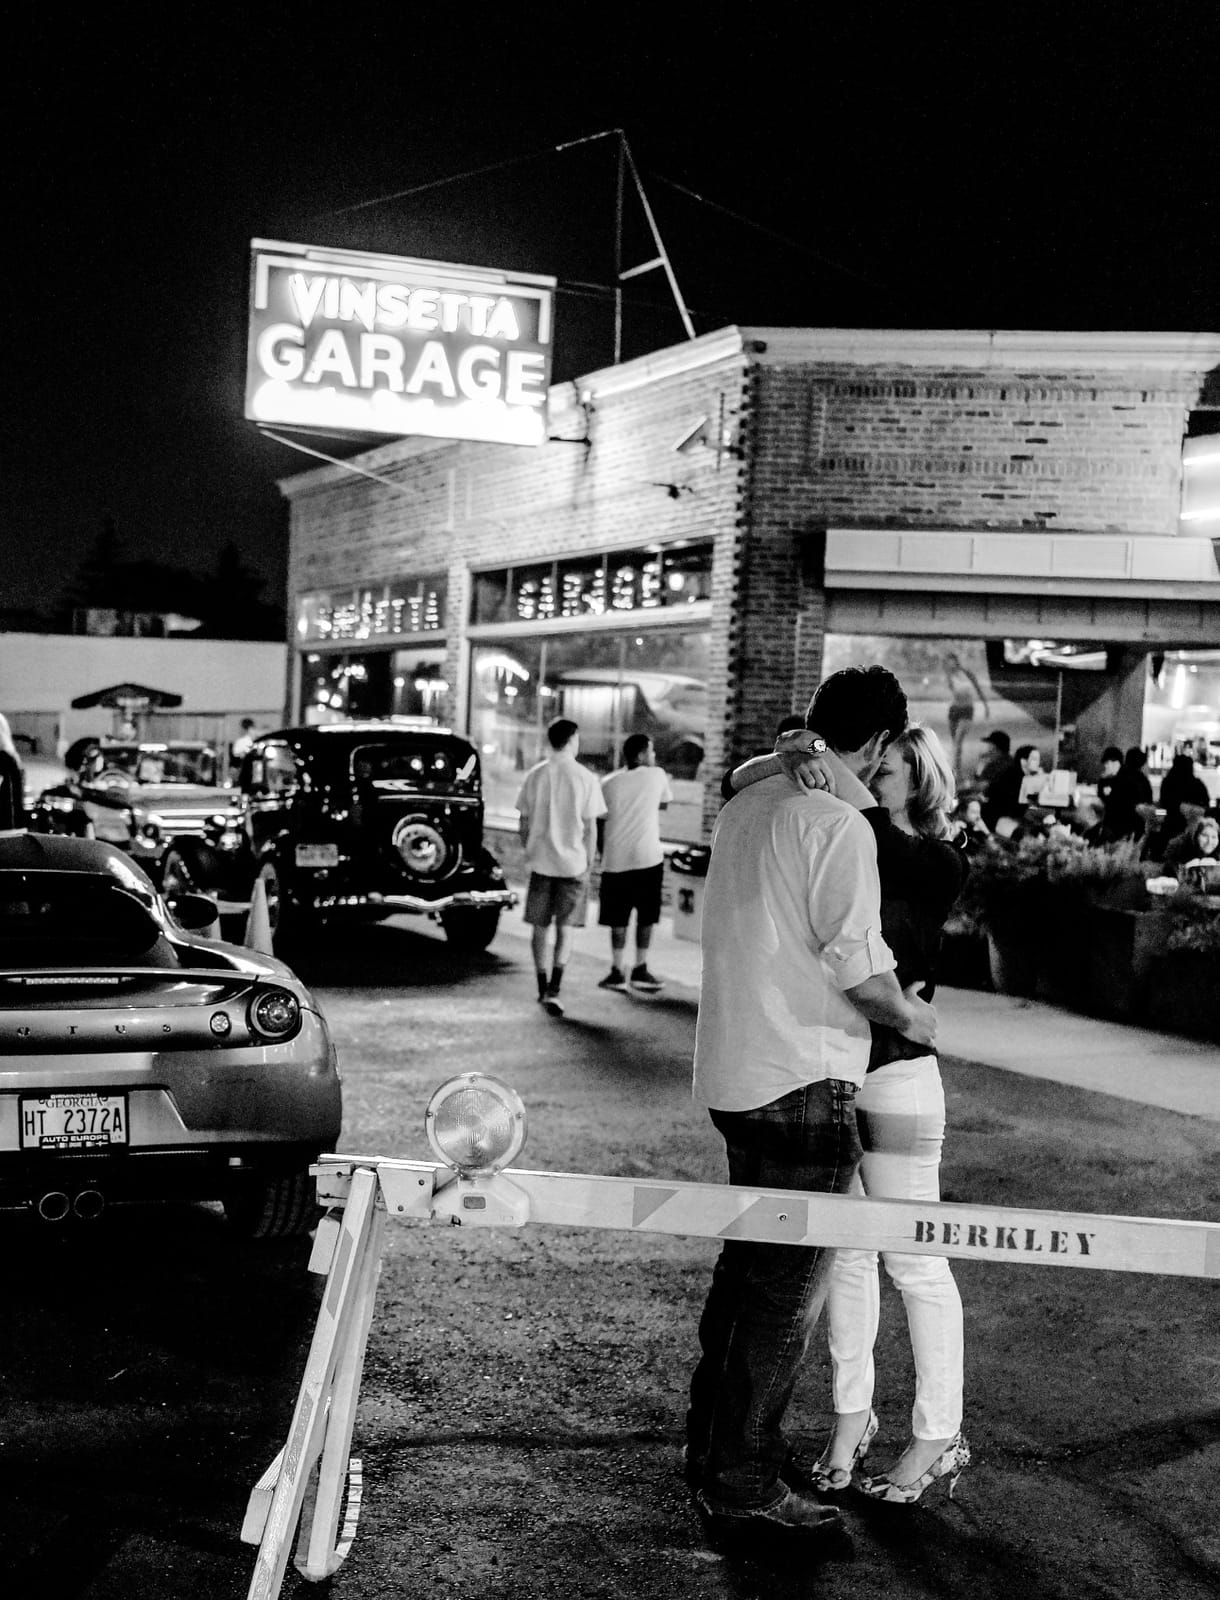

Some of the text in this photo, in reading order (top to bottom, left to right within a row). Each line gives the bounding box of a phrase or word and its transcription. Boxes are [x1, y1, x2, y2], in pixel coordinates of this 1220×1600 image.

[288, 273, 520, 341] VINSETTA
[256, 323, 547, 406] GARAGE
[45, 1097, 104, 1108] GEORGIA
[24, 1107, 122, 1136] HT 2372A
[70, 1134, 109, 1142] EUROPE
[914, 1219, 1096, 1256] BERKLEY
